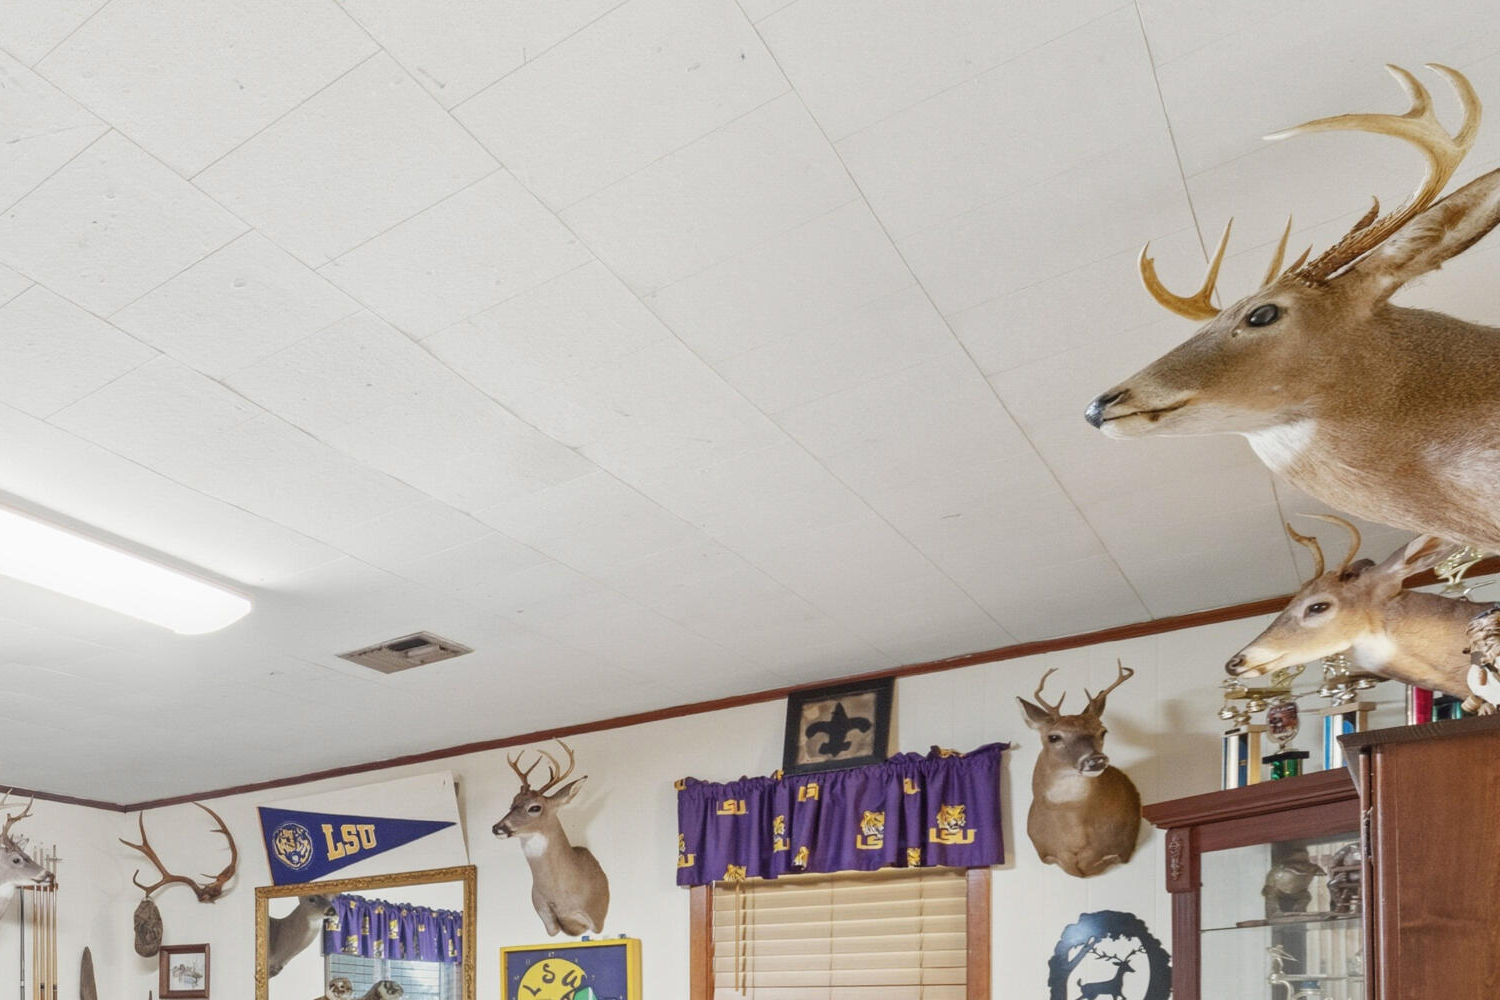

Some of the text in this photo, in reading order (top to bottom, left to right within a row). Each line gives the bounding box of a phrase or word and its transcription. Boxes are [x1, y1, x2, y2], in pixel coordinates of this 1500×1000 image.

[321, 824, 377, 861] LSU
[856, 834, 883, 849] LS
[929, 828, 976, 844] LSU
[523, 963, 579, 997] LSU
